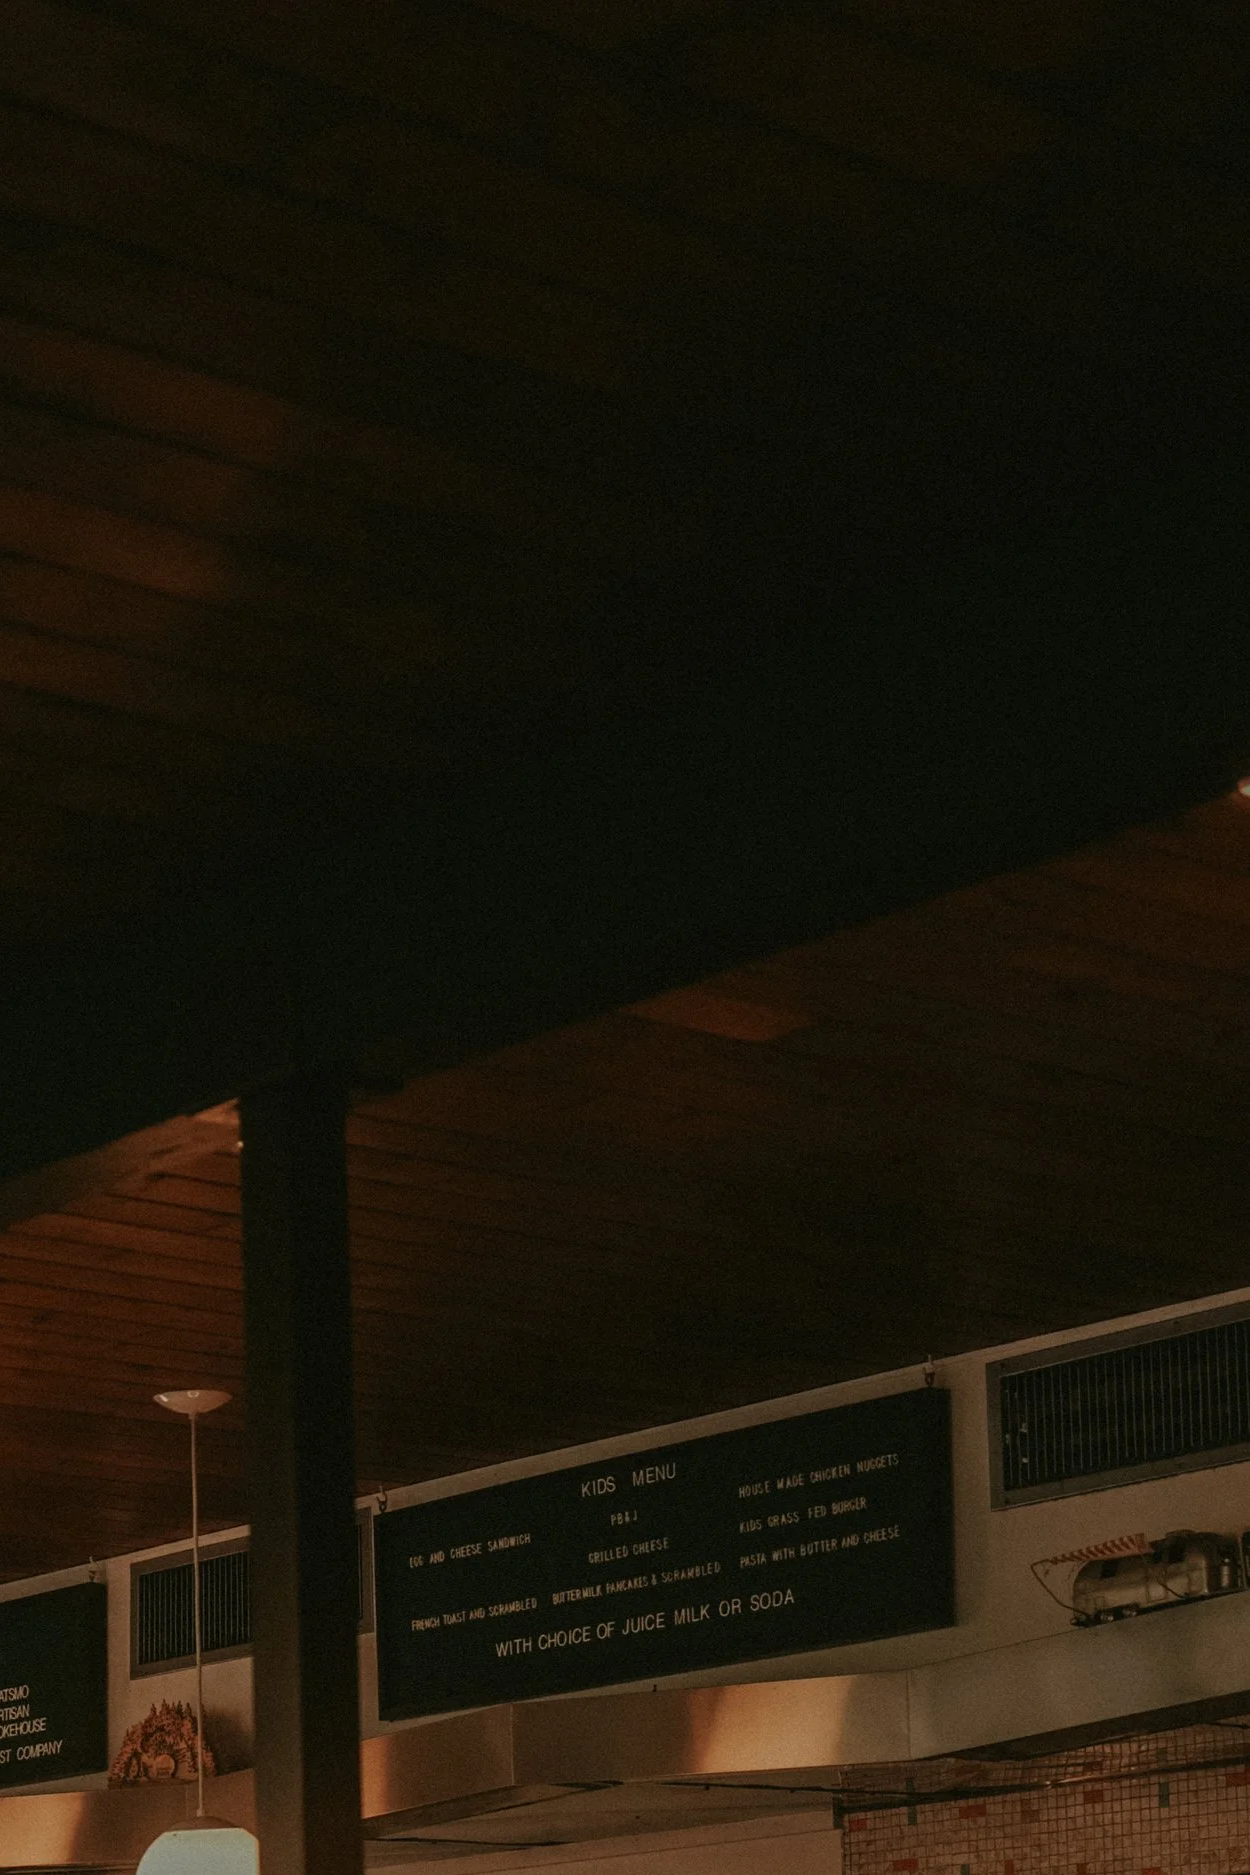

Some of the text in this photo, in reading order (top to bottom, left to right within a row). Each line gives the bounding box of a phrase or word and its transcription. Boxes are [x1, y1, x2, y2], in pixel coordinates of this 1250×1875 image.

[581, 1462, 676, 1497] KIDS MENU
[739, 1453, 899, 1498] HOUSE MADE CHICKEN NUGGETS
[740, 1497, 867, 1533] KIDS GRASS FED BURGER
[429, 1551, 445, 1564] AND
[450, 1543, 482, 1559] CHEESE
[487, 1533, 531, 1552] SANDWICH
[588, 1537, 669, 1564] GRILLED CHEESE
[740, 1525, 900, 1568] PASTA WITH BUTTER AND CHEESE
[552, 1584, 602, 1605] BUTTERMILK
[606, 1576, 648, 1594] PANCAKES
[661, 1561, 721, 1583] SCRAMBLED
[411, 1597, 537, 1631] FRENCH TOAST AND SCRAMBLED
[495, 1588, 795, 1657] WITH CHOICE OF JUICE MILK OR SODA
[16, 1740, 63, 1760] COMPANY
